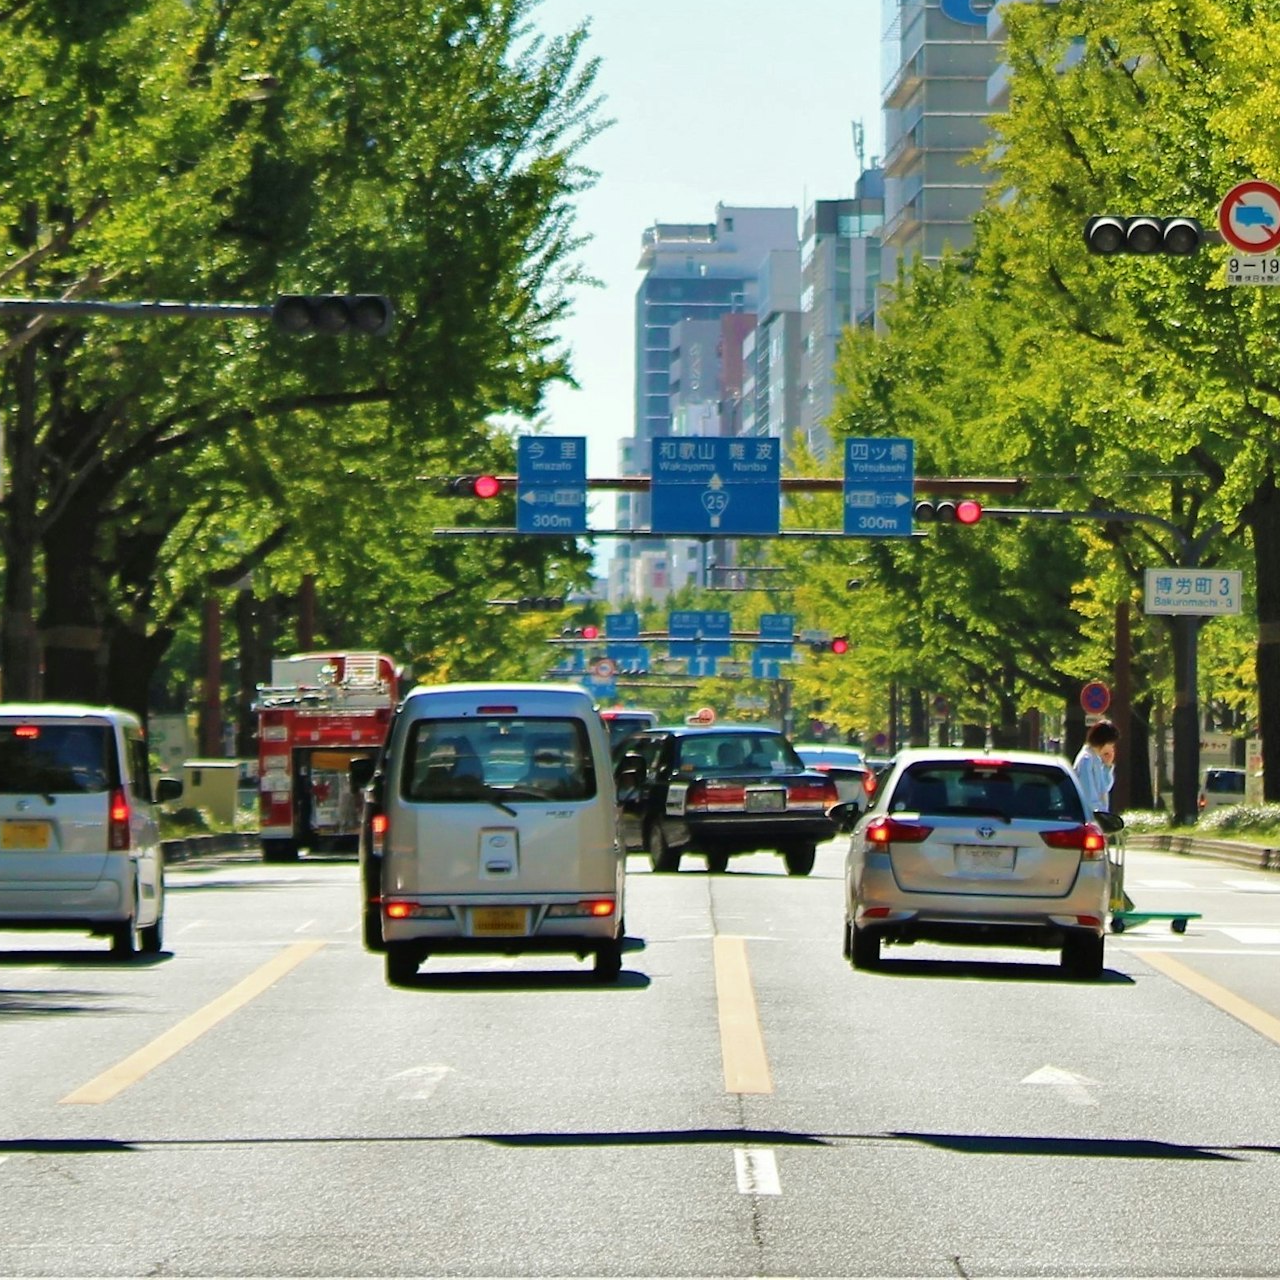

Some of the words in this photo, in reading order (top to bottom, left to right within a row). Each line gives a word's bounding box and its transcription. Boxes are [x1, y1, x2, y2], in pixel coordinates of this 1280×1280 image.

[660, 442, 716, 460] 和歌山
[729, 443, 773, 460] 難波
[532, 461, 572, 472] Imazato
[660, 462, 716, 473] Wakayama
[733, 463, 768, 472] Nanba
[853, 463, 906, 473] Yotsubashi
[707, 495, 724, 510] 25
[532, 514, 572, 528] 300m
[858, 516, 898, 529] 300m
